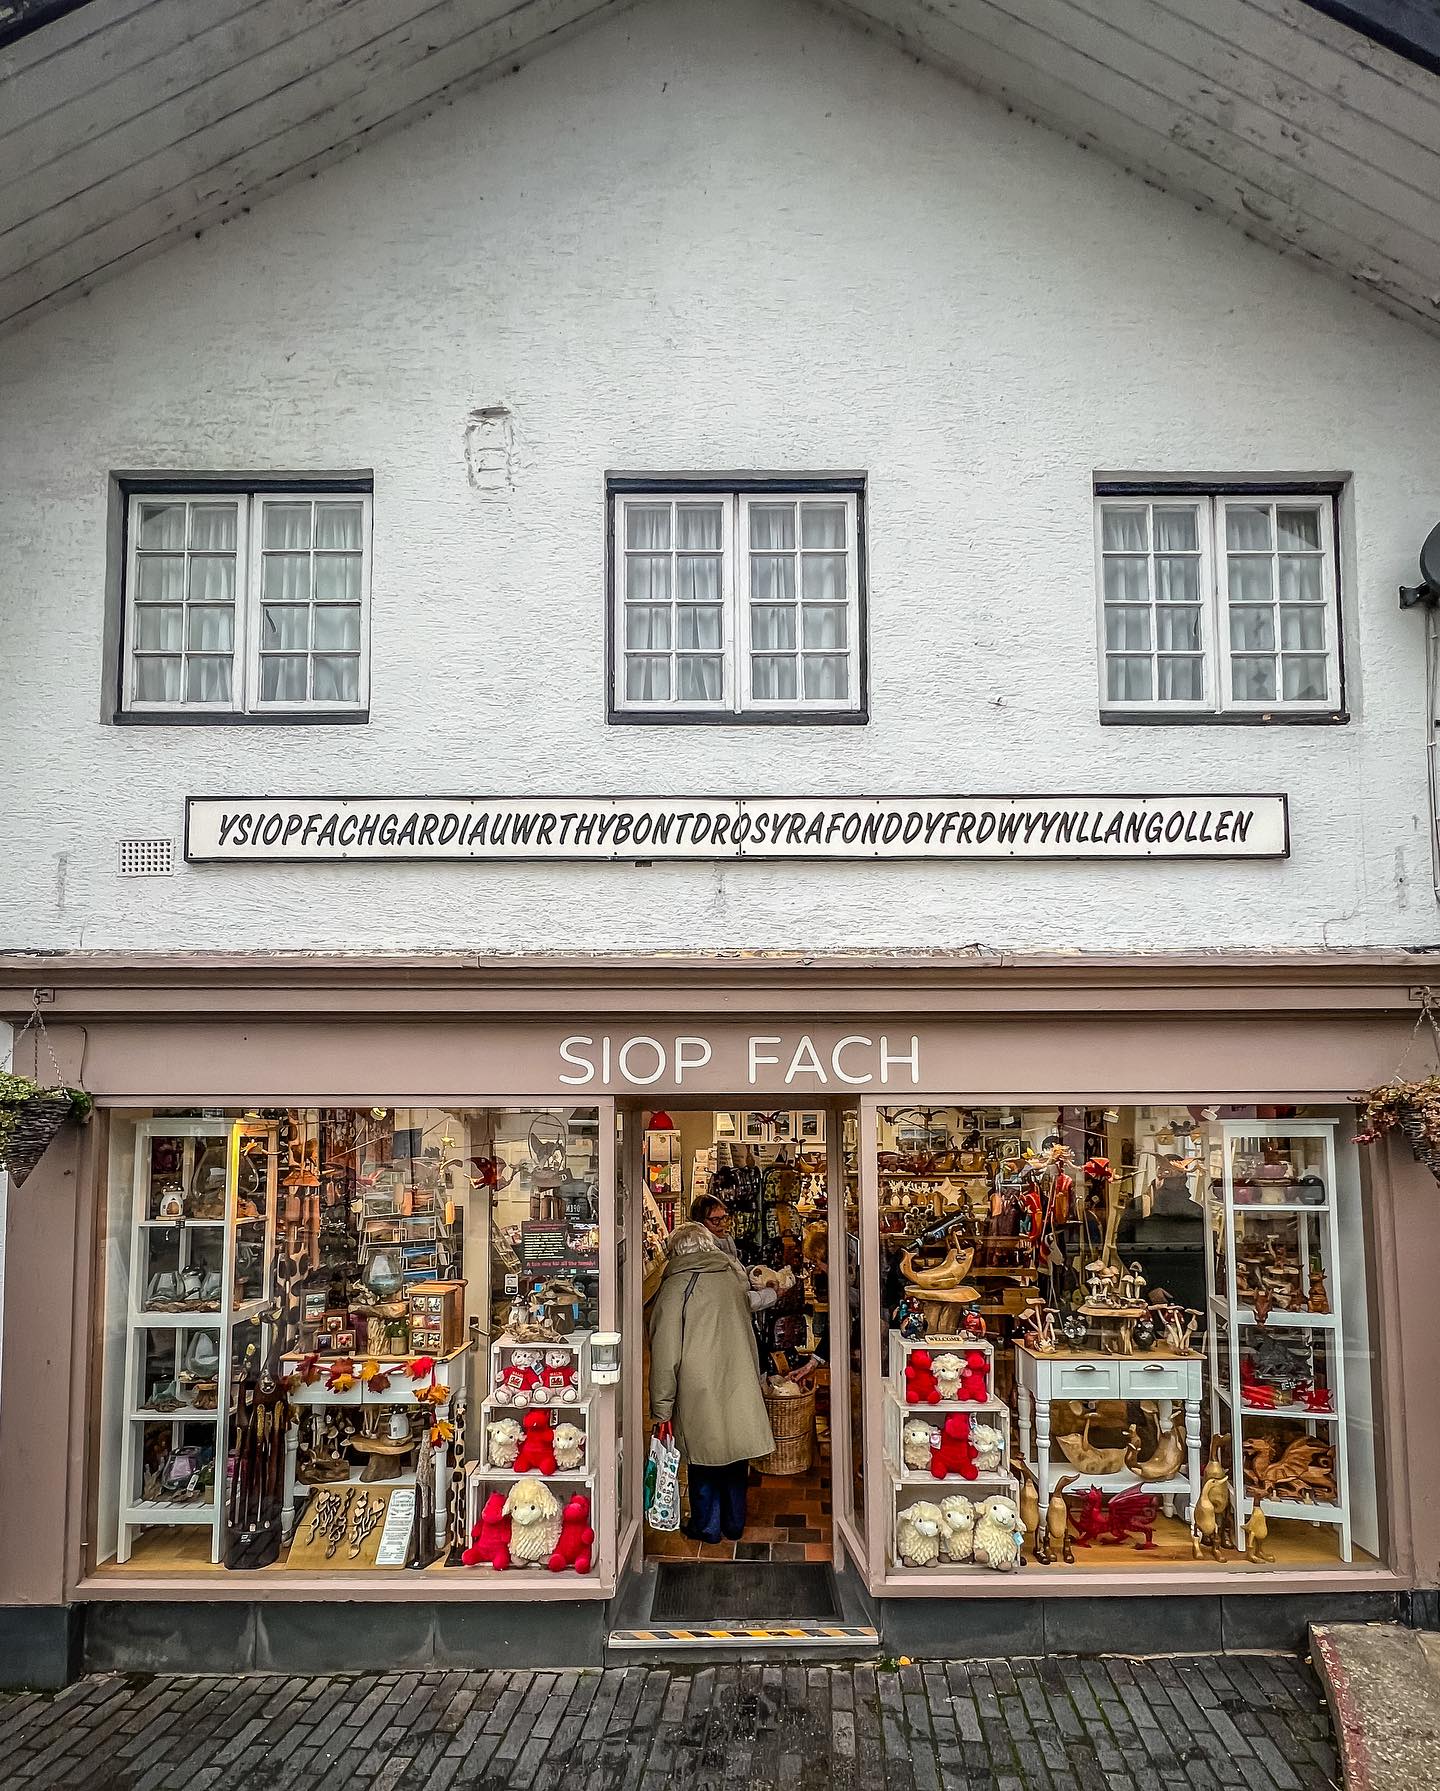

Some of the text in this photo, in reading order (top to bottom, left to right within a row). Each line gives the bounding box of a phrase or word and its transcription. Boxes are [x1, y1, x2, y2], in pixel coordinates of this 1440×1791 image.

[217, 810, 1253, 846] YSIOPFACHGARDIAUWRTHYBONTDROSYRAFONDDYFRDWYYNLLANGOLLEN
[558, 1035, 921, 1085] SIOP FACH
